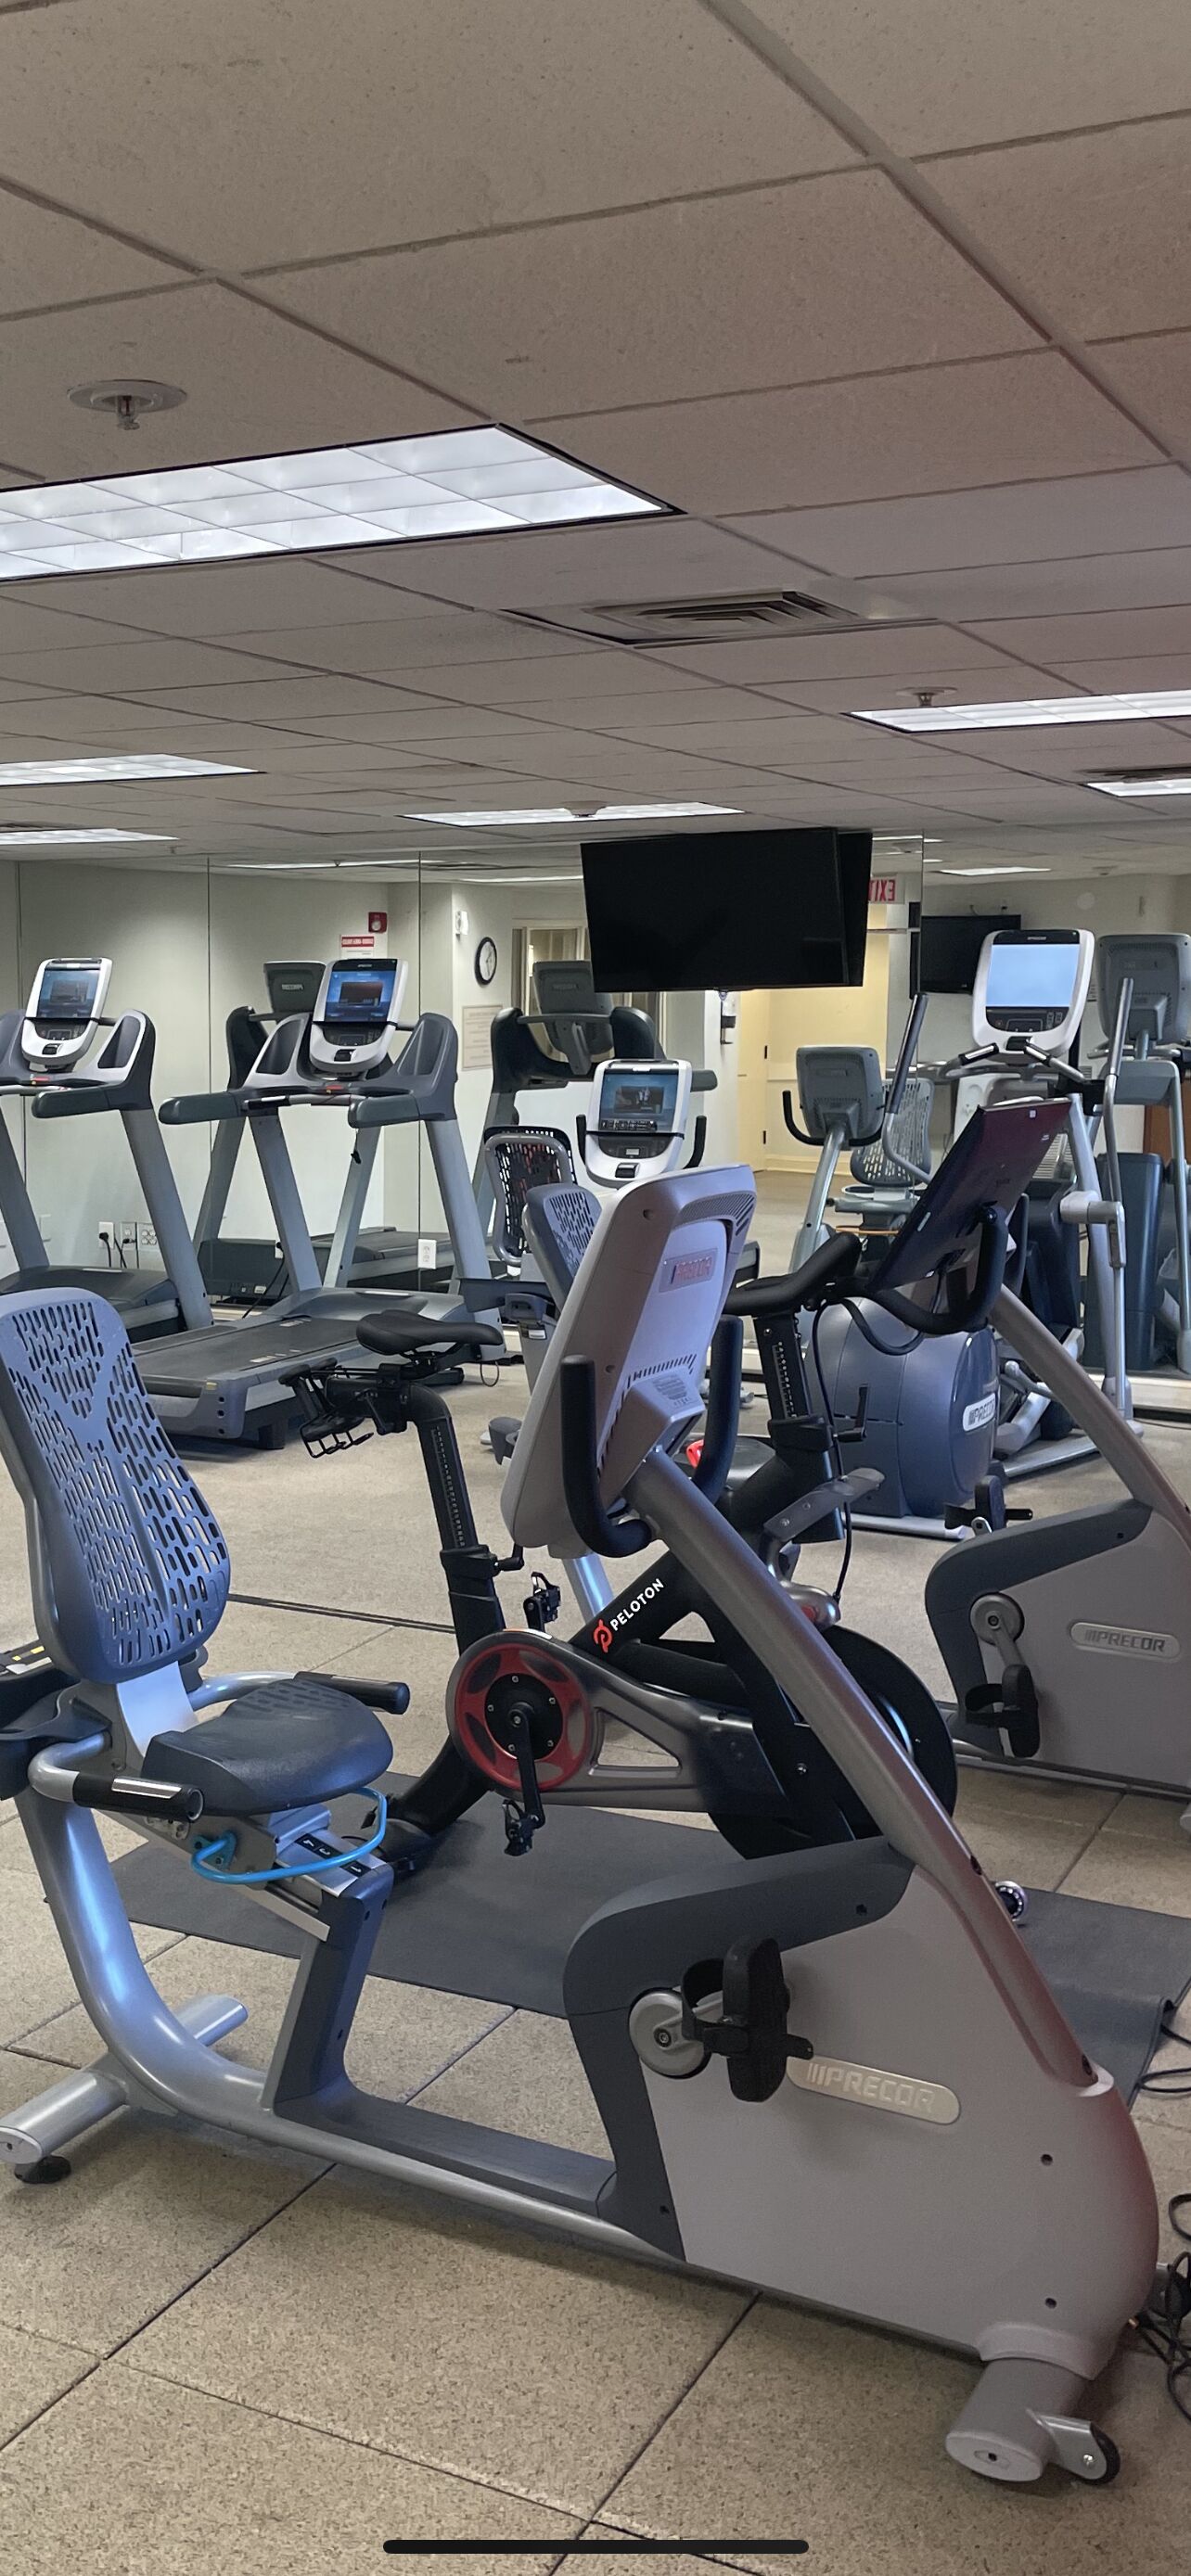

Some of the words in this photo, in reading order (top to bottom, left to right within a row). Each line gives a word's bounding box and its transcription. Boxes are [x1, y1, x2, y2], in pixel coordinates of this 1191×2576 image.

[609, 1578, 664, 1631] PELOTON
[1095, 1630, 1166, 1652] PRECOR
[823, 2067, 936, 2113] PRECOR
